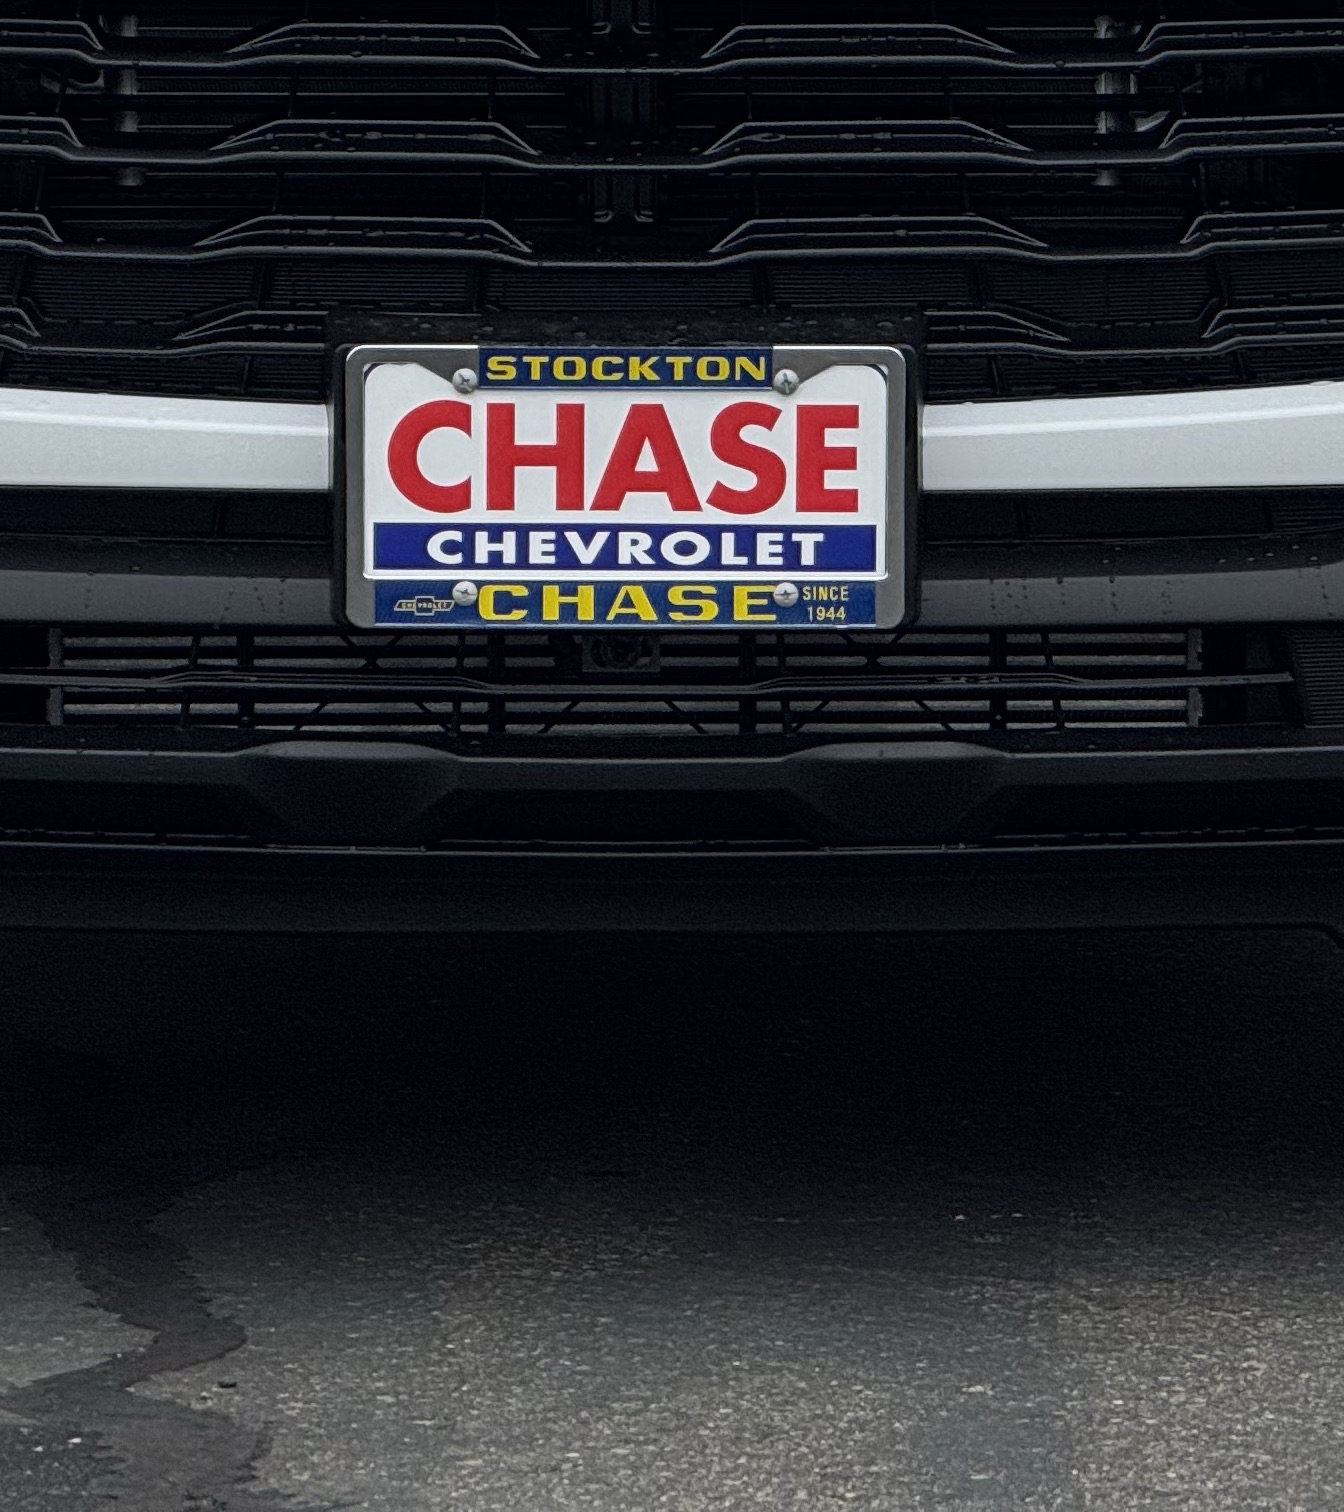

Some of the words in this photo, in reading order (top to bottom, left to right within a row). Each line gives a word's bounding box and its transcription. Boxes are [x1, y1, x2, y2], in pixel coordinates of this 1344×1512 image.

[486, 355, 766, 381] STOCKTON
[387, 399, 860, 515] CHASE
[426, 530, 825, 566] CHEVROLET
[478, 584, 778, 622] CHASE
[802, 585, 850, 601] SINCE
[807, 606, 846, 621] 1944
